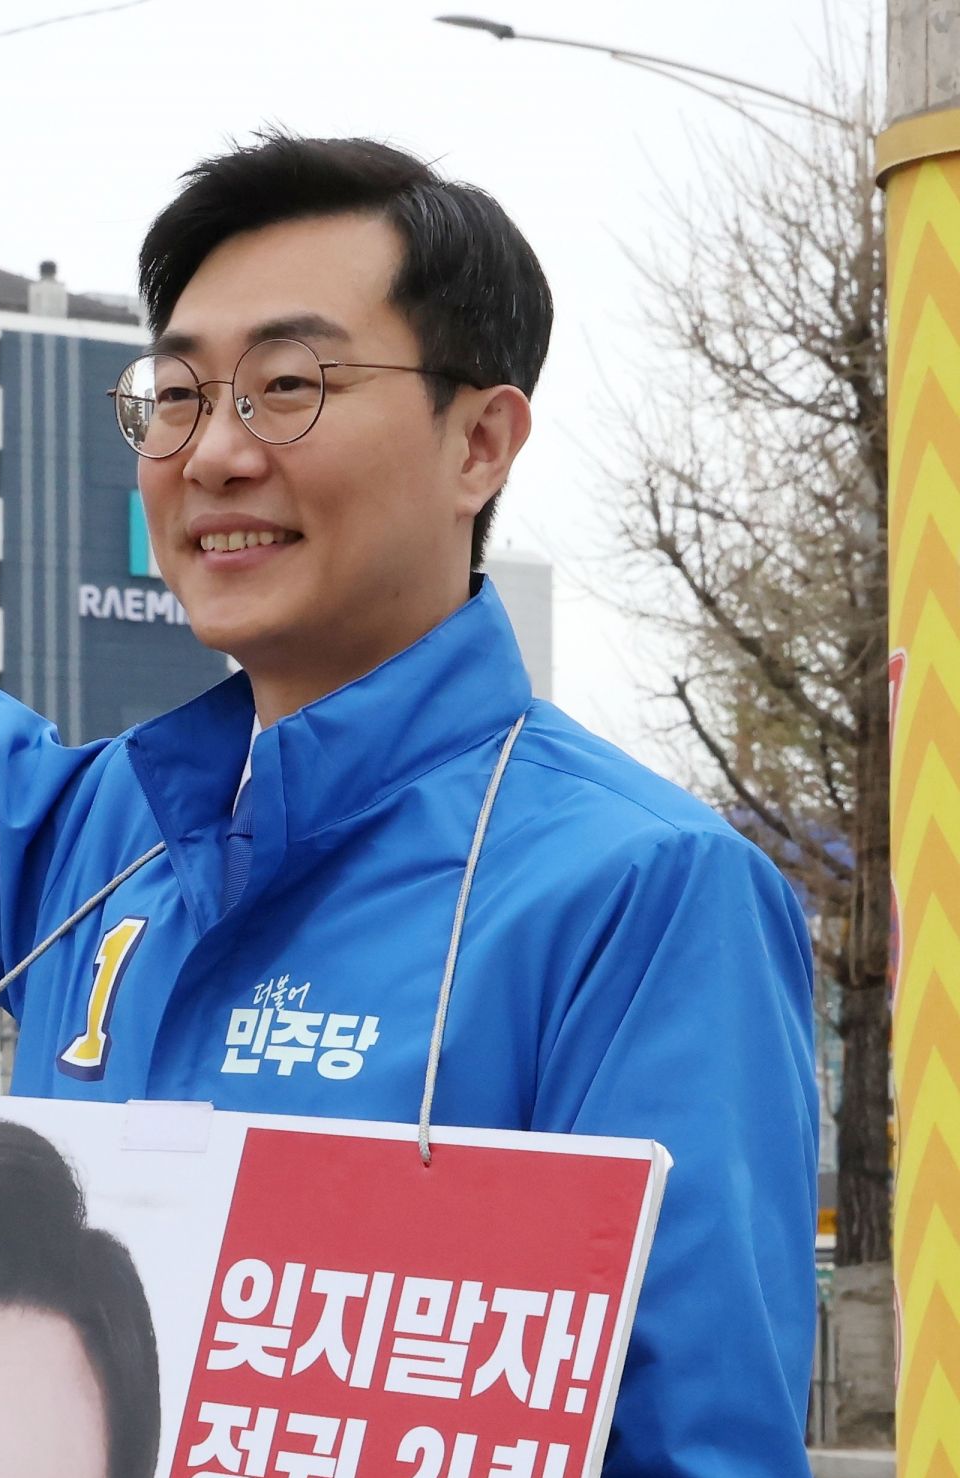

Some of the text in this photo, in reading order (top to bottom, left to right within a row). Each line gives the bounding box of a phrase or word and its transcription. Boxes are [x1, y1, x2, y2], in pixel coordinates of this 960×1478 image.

[79, 584, 190, 625] RAEMI
[60, 917, 147, 1070] 1
[253, 974, 310, 1009] 더불어
[220, 1008, 380, 1080] 민주당
[206, 1258, 610, 1414] 잊지말자!
